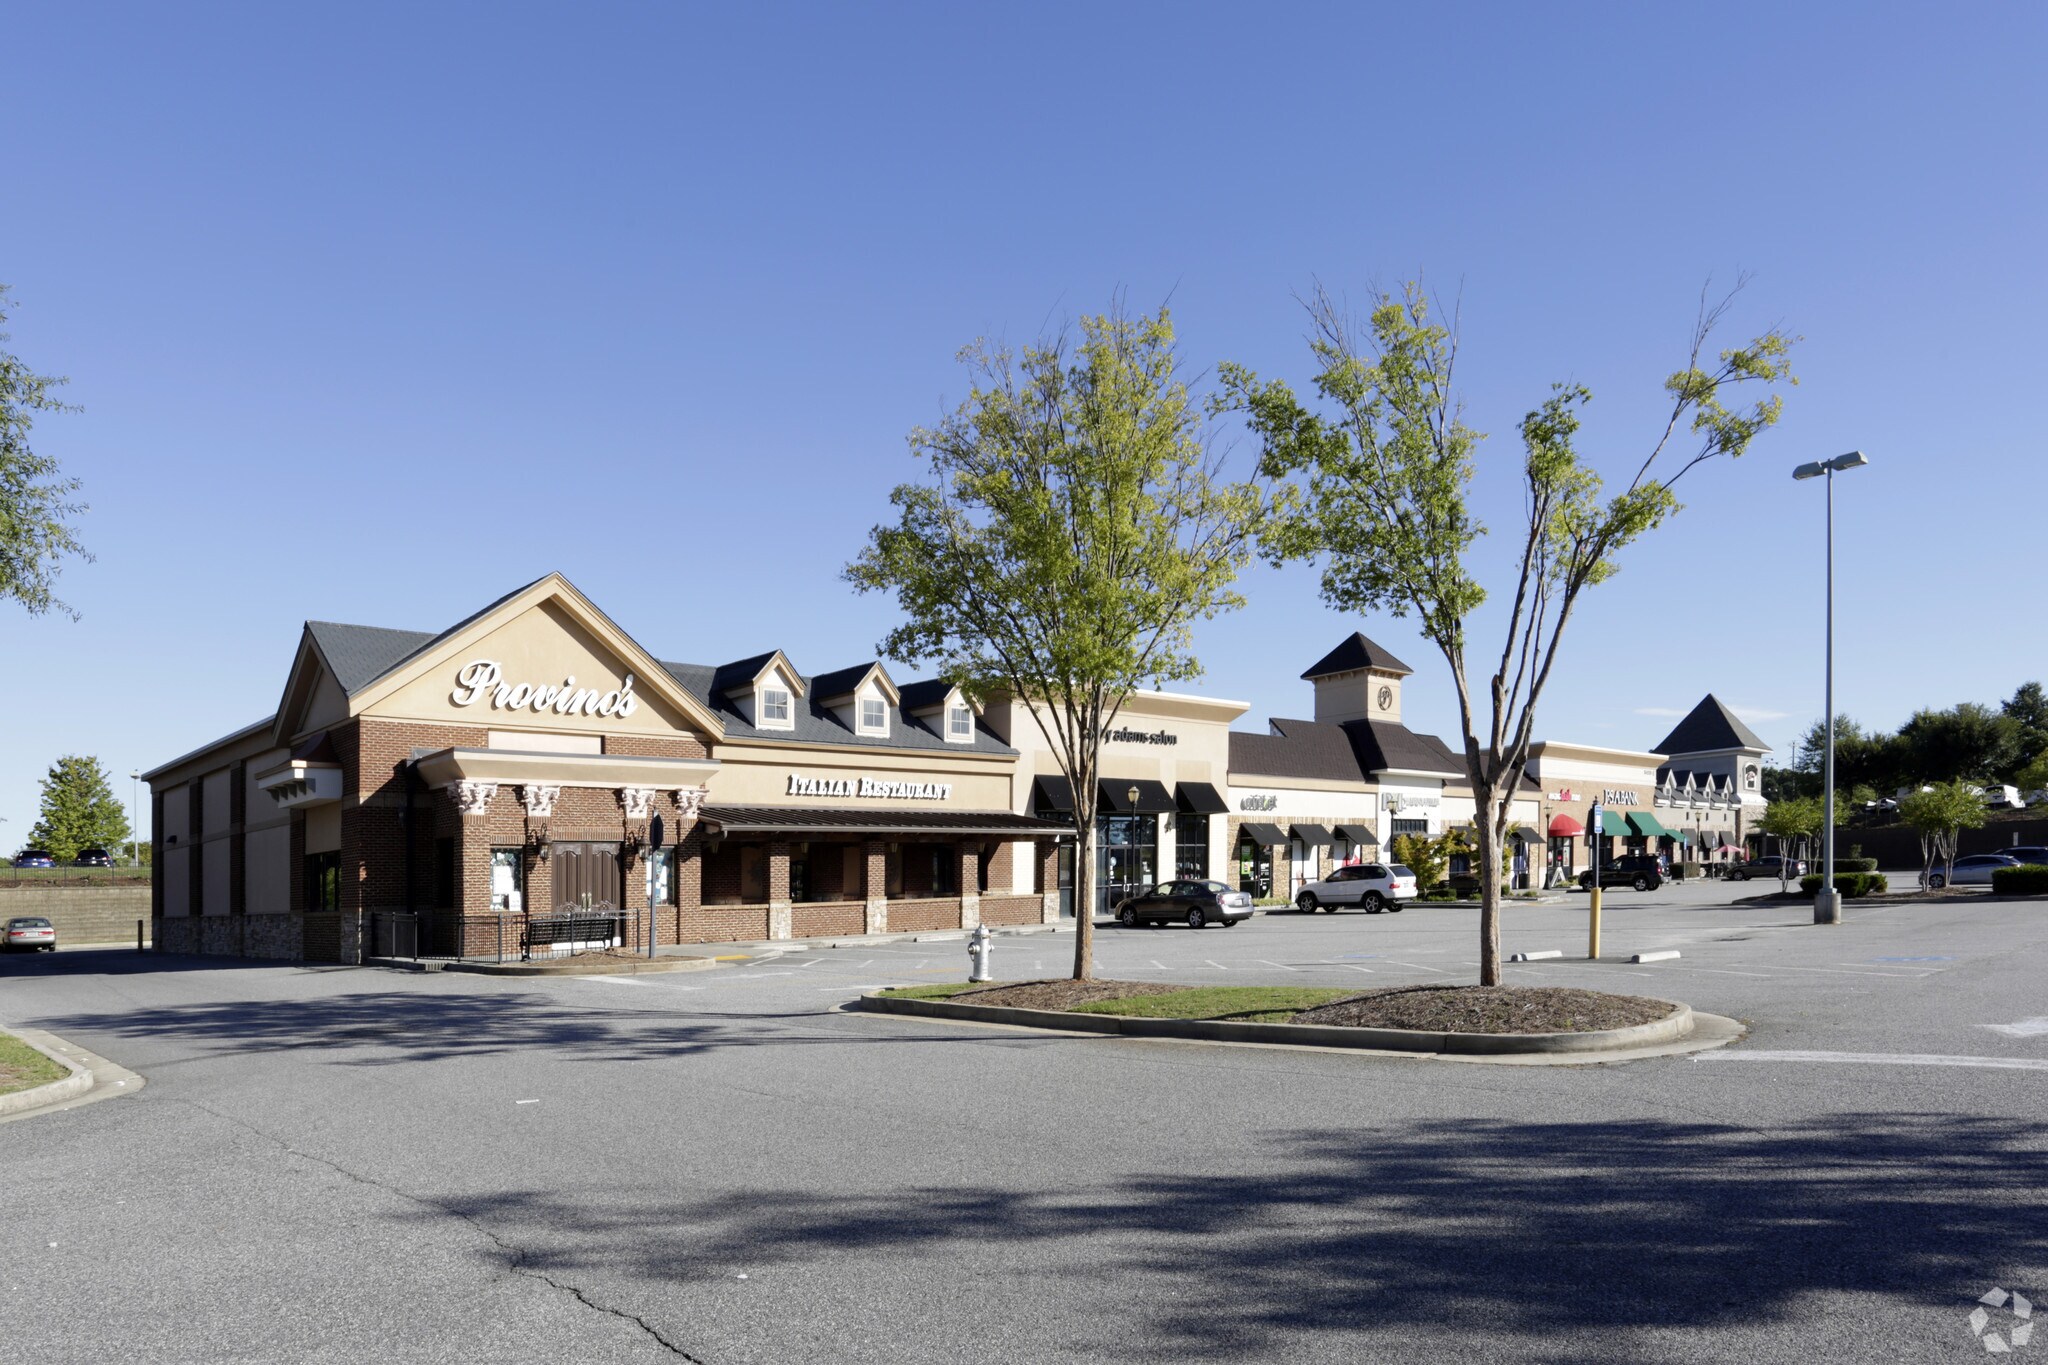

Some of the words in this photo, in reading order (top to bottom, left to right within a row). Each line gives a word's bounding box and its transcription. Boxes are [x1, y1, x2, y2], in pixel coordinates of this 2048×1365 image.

[451, 659, 638, 717] Provino's
[1112, 726, 1149, 744] adams
[1149, 729, 1178, 746] salon
[858, 776, 953, 800] RESTAURANT
